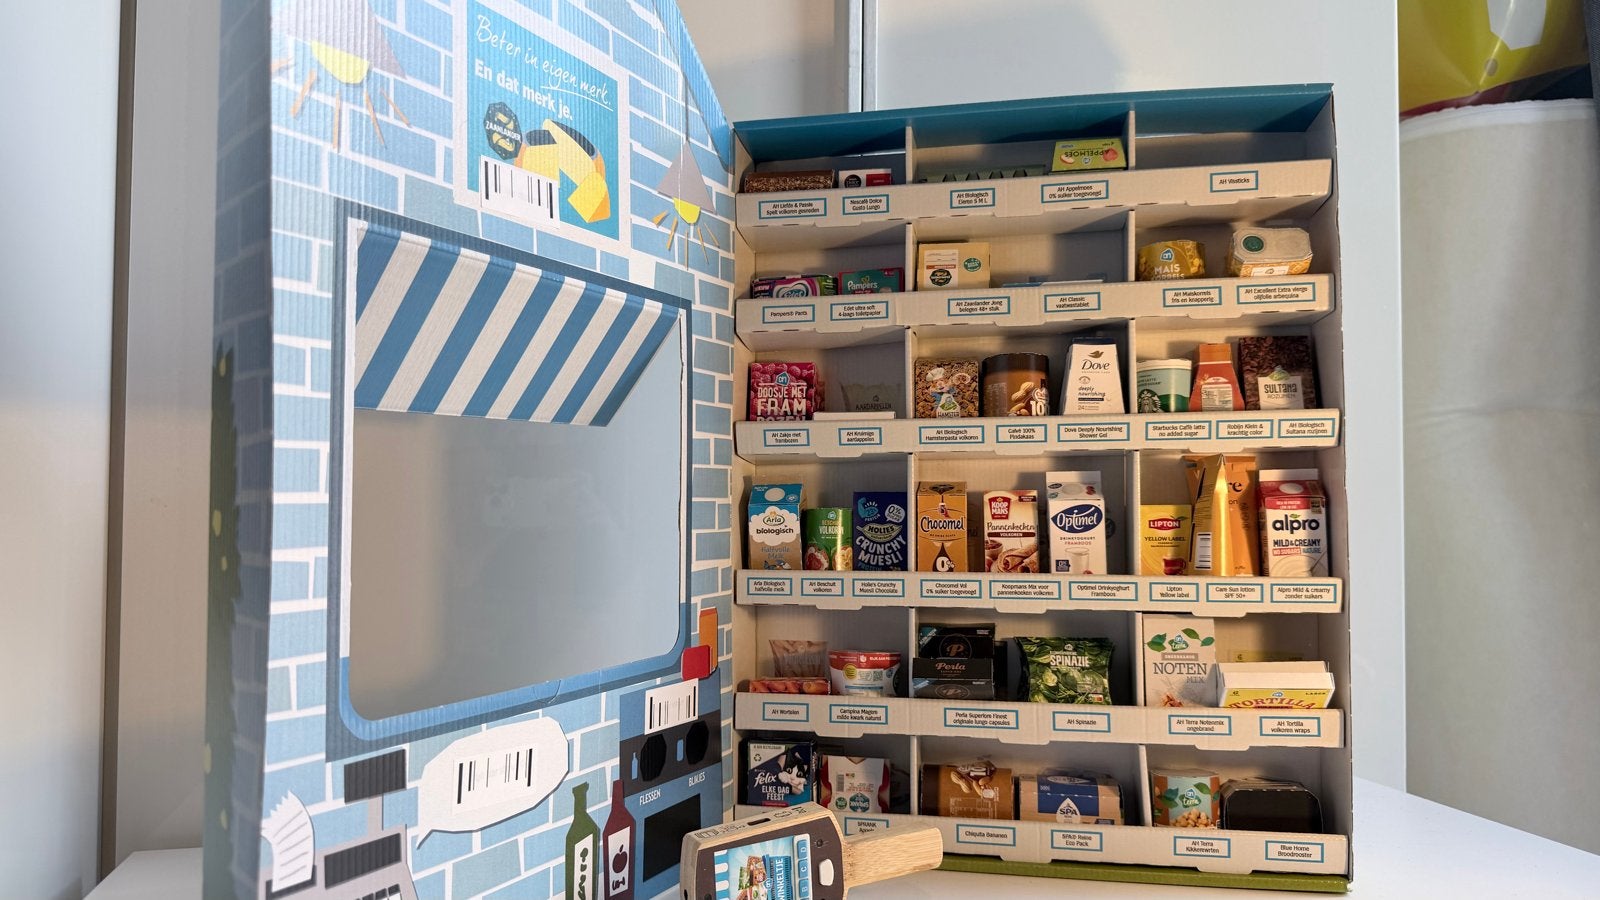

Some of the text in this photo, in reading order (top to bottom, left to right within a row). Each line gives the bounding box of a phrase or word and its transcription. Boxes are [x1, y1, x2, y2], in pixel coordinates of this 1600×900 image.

[476, 14, 611, 105] Beter in eigen merk.
[475, 58, 573, 120] En dat merk je.
[1066, 185, 1092, 193] Appelmoes
[1155, 264, 1180, 273] MAIS
[848, 279, 878, 291] Pampers
[1082, 359, 1110, 371] Dove
[758, 387, 807, 397] DOOSJE MET
[757, 399, 806, 415] FRAM
[920, 517, 964, 533] Chocomel
[1057, 508, 1097, 530] Optimel
[1150, 520, 1179, 528] LIPTON
[1272, 514, 1319, 534] alpro
[756, 527, 793, 535] biologisch
[987, 522, 1035, 531] Pannenkoeken
[855, 535, 907, 555] CRUNCHY
[858, 552, 903, 566] MUESLI
[935, 662, 966, 670] Perla
[1050, 656, 1090, 667] SPINAZIE
[1153, 663, 1207, 675] NOTEN
[1229, 698, 1315, 708] TORTILLA
[689, 772, 705, 787] BLIKJES
[754, 773, 777, 787] felix
[762, 785, 790, 794] ELKE DAG
[640, 789, 661, 806] FLESSEN
[1183, 798, 1199, 806] terra
